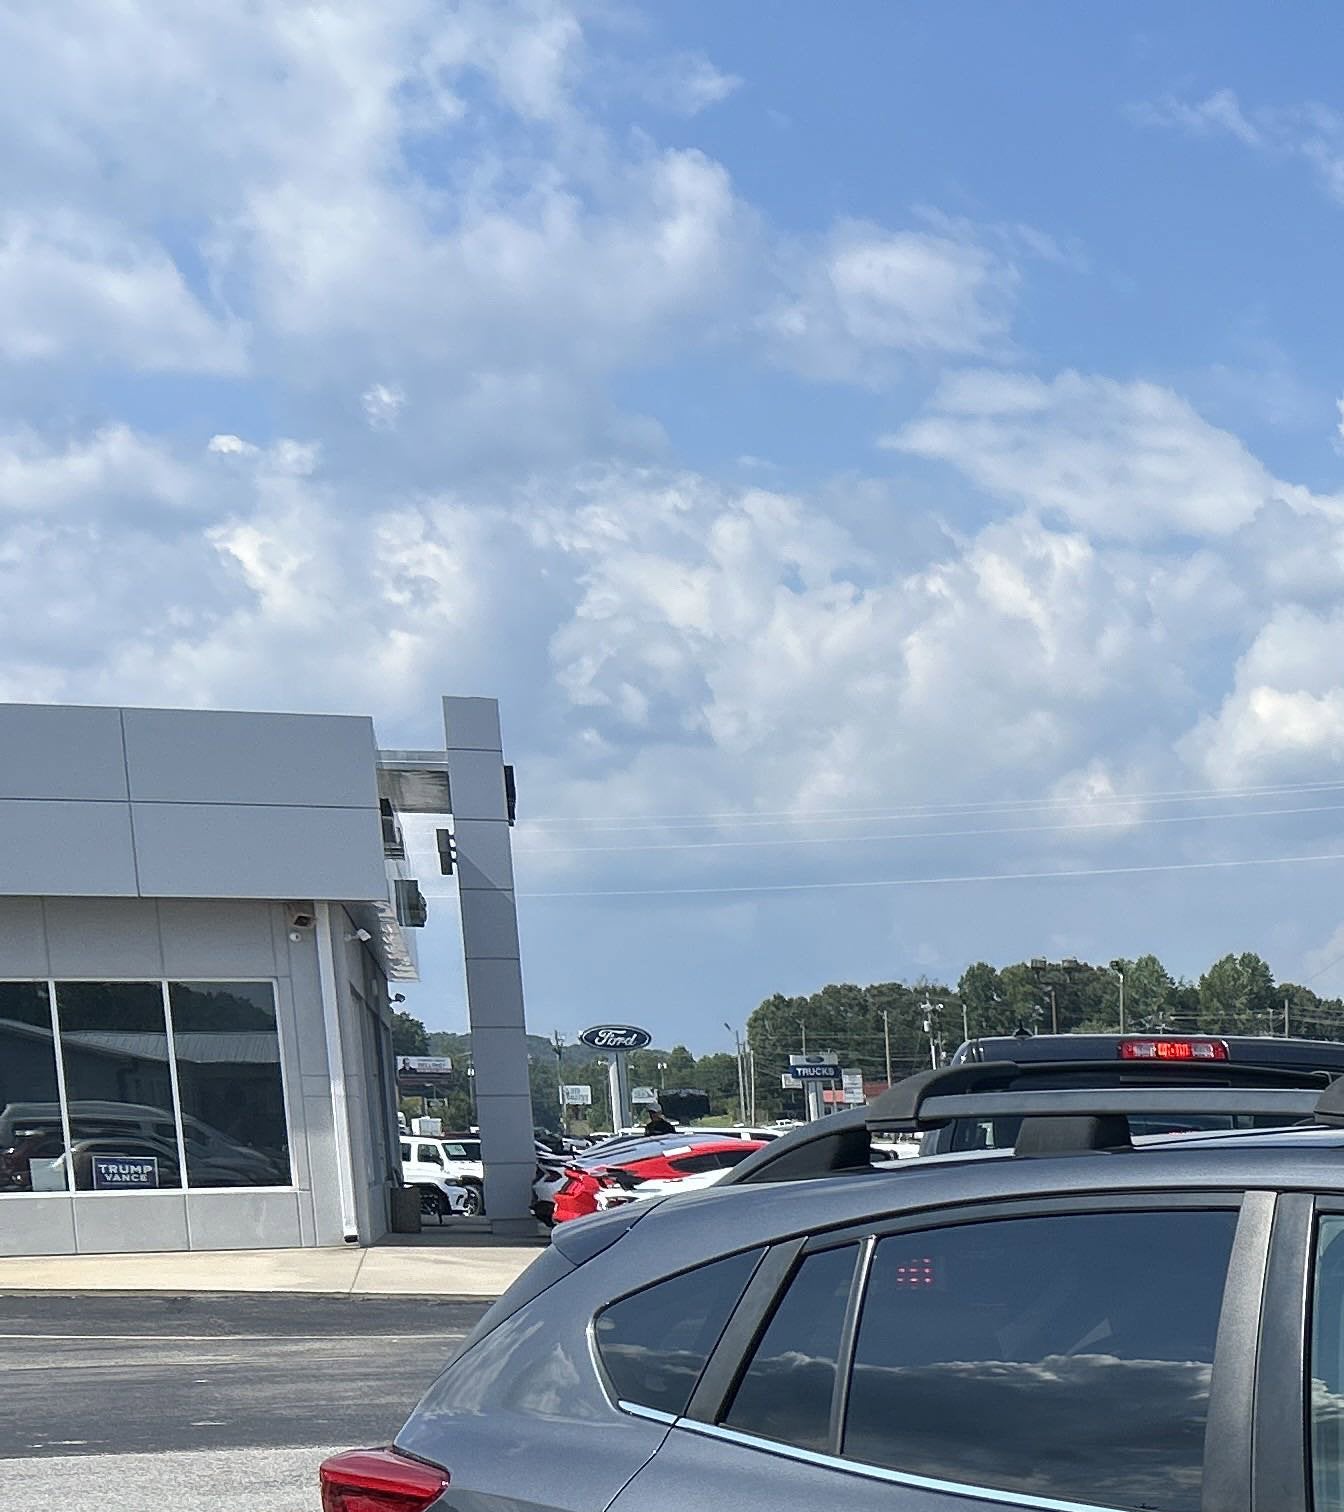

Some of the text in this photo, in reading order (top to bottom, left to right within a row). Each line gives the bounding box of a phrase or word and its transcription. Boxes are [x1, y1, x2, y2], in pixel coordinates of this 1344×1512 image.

[594, 1029, 638, 1046] Ford
[796, 1067, 835, 1076] TRUCKS
[97, 1164, 153, 1174] TRUMP
[104, 1173, 148, 1182] VANCE
